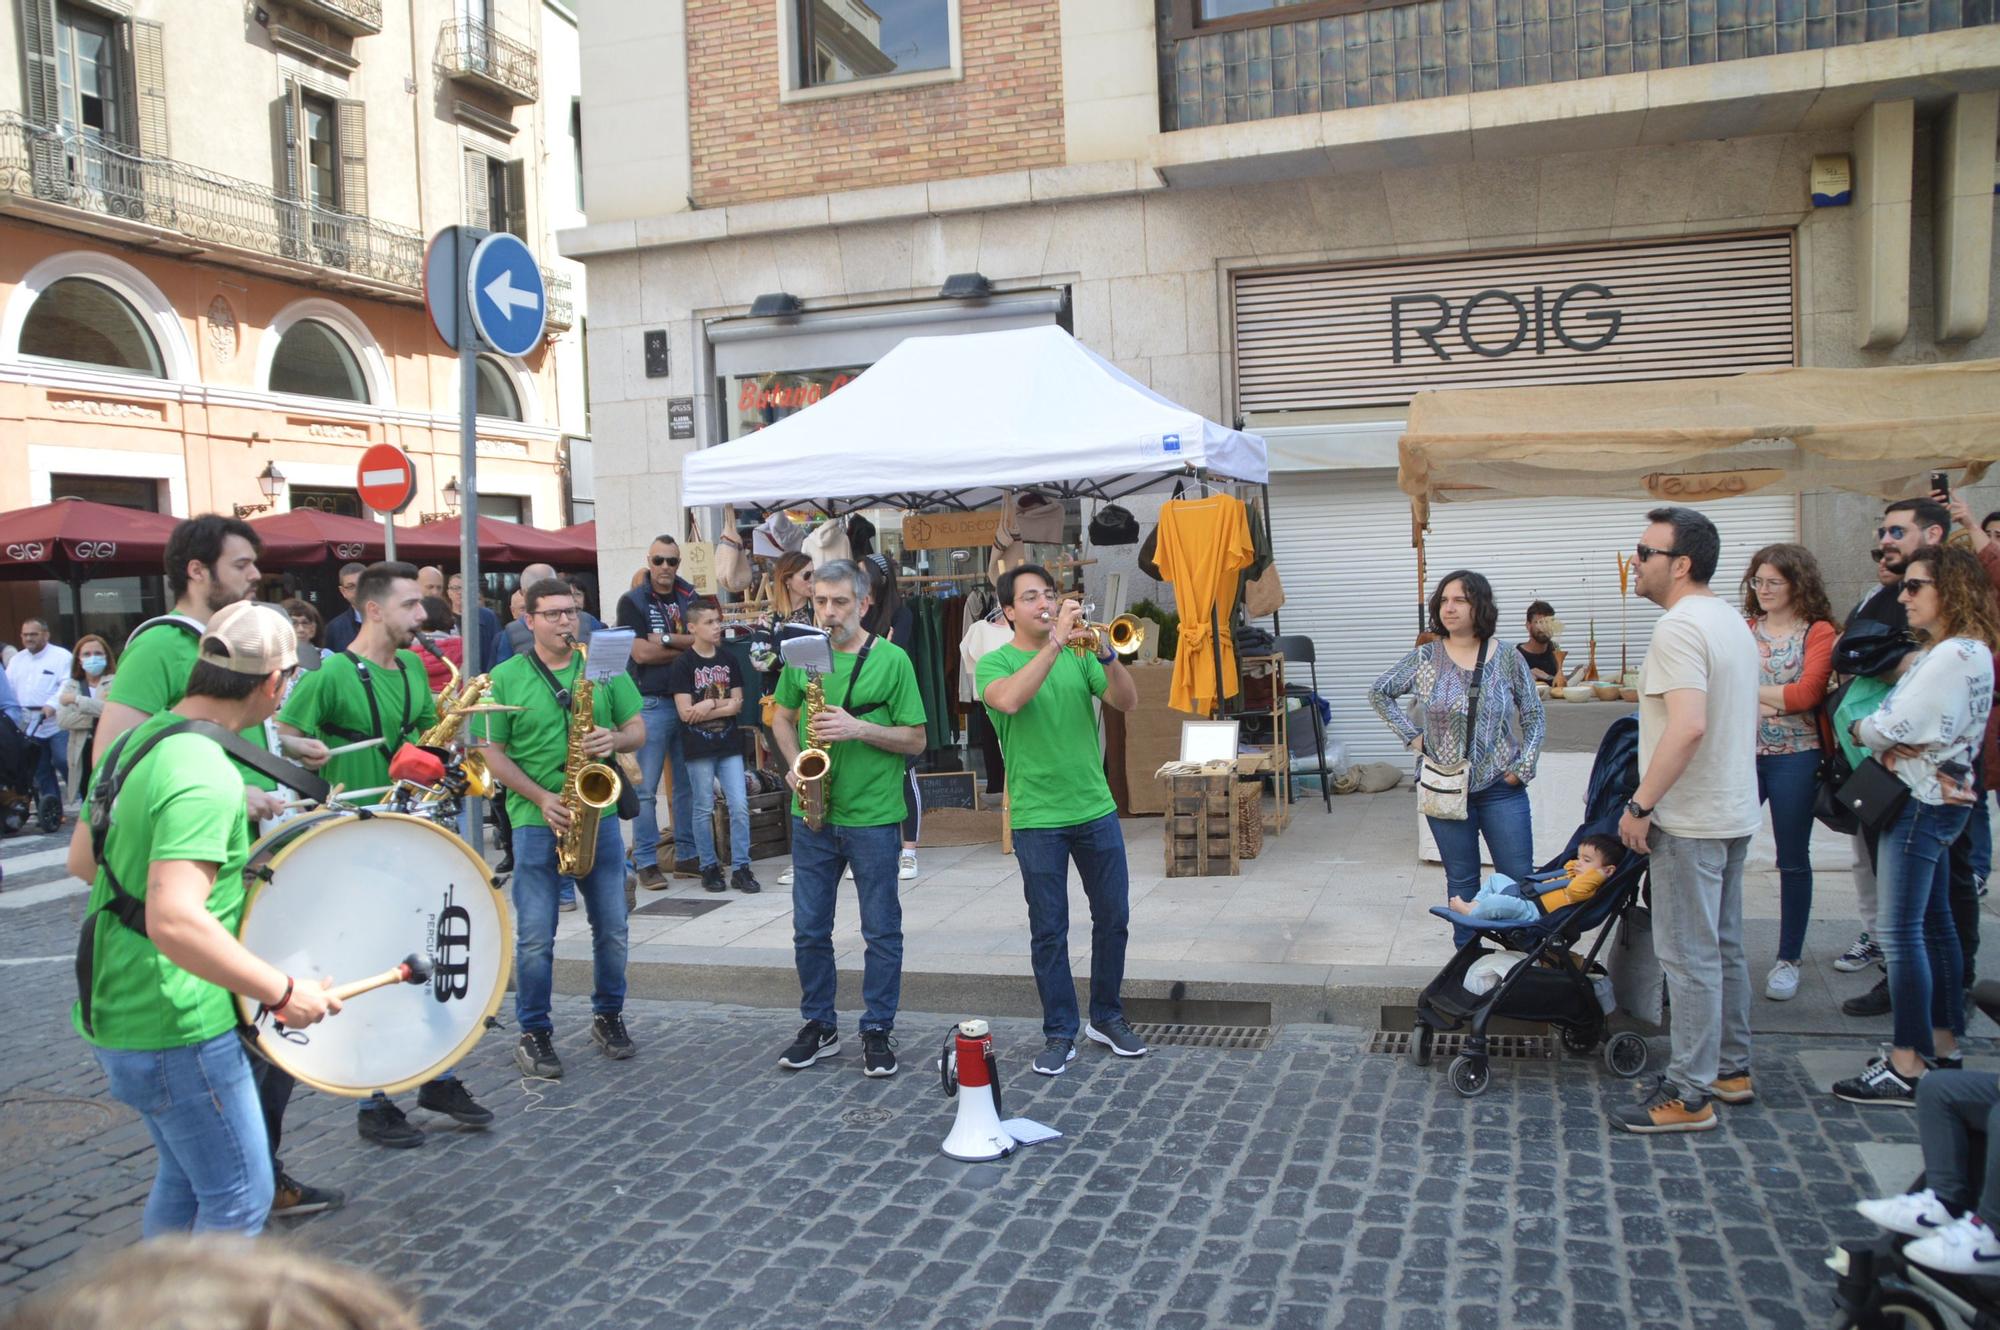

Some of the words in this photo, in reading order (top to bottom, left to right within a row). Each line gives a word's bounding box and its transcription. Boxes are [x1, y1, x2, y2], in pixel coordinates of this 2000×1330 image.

[1391, 283, 1622, 363] ROIG
[738, 381, 821, 411] Butano
[6, 543, 44, 560] GIGI
[75, 542, 116, 558] GIGI
[337, 543, 365, 557] GIGI
